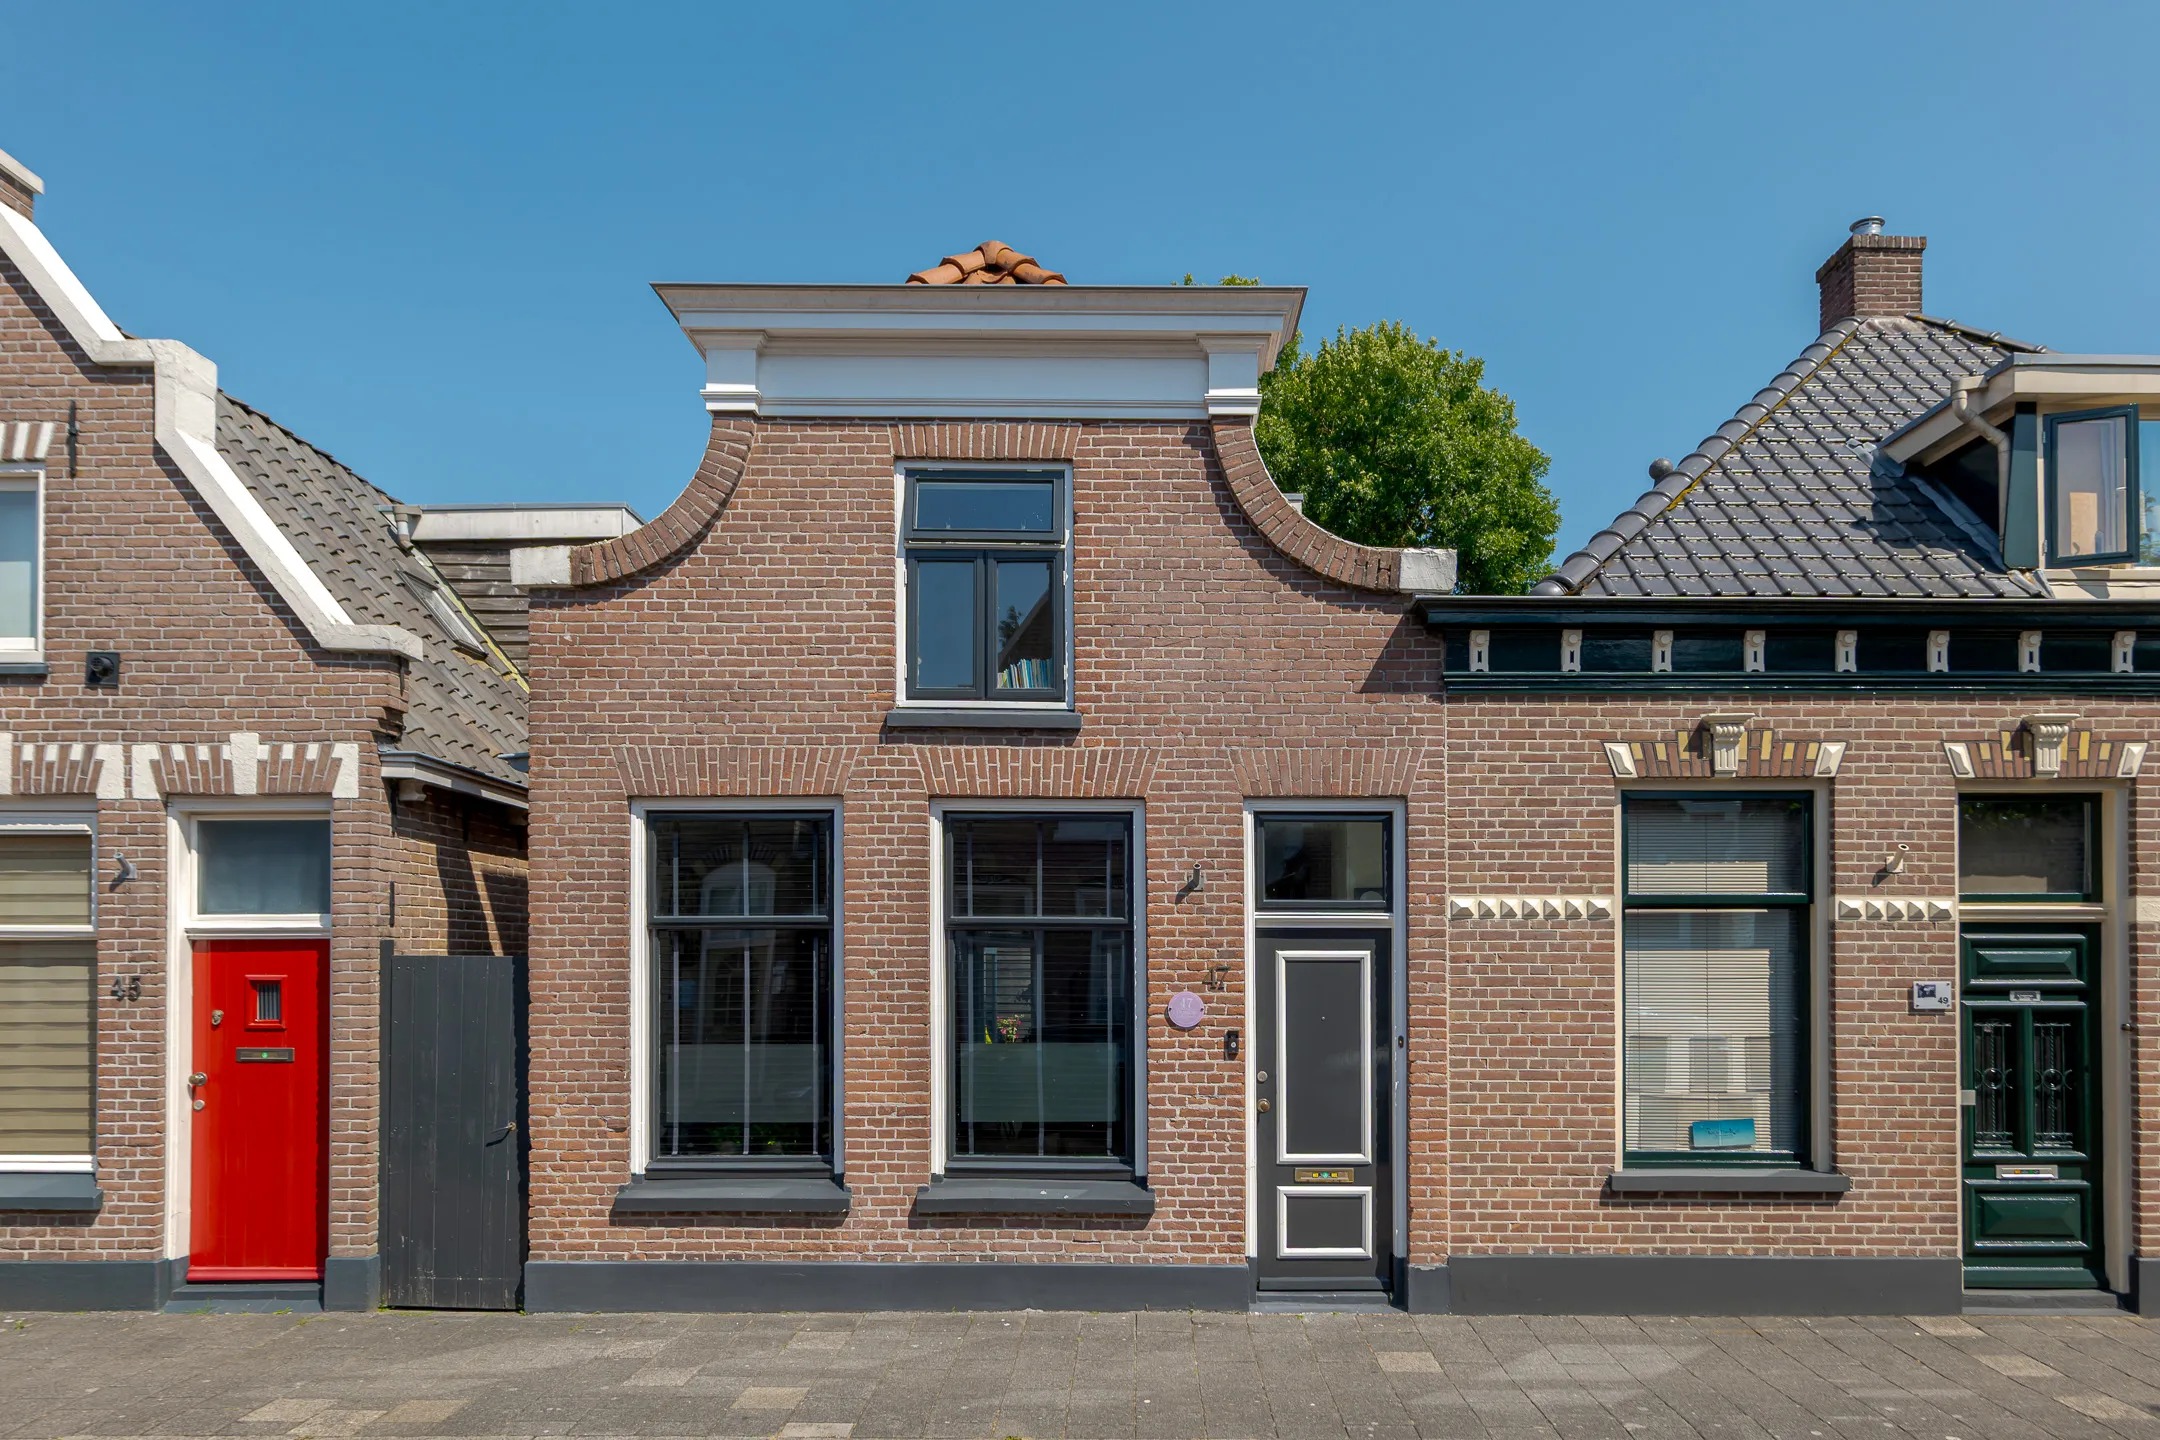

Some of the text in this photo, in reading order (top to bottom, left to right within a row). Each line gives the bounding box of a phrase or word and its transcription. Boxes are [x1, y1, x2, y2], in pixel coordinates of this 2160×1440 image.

[111, 975, 141, 1001] 45
[1202, 965, 1231, 990] 47
[1937, 996, 1949, 1005] 49
